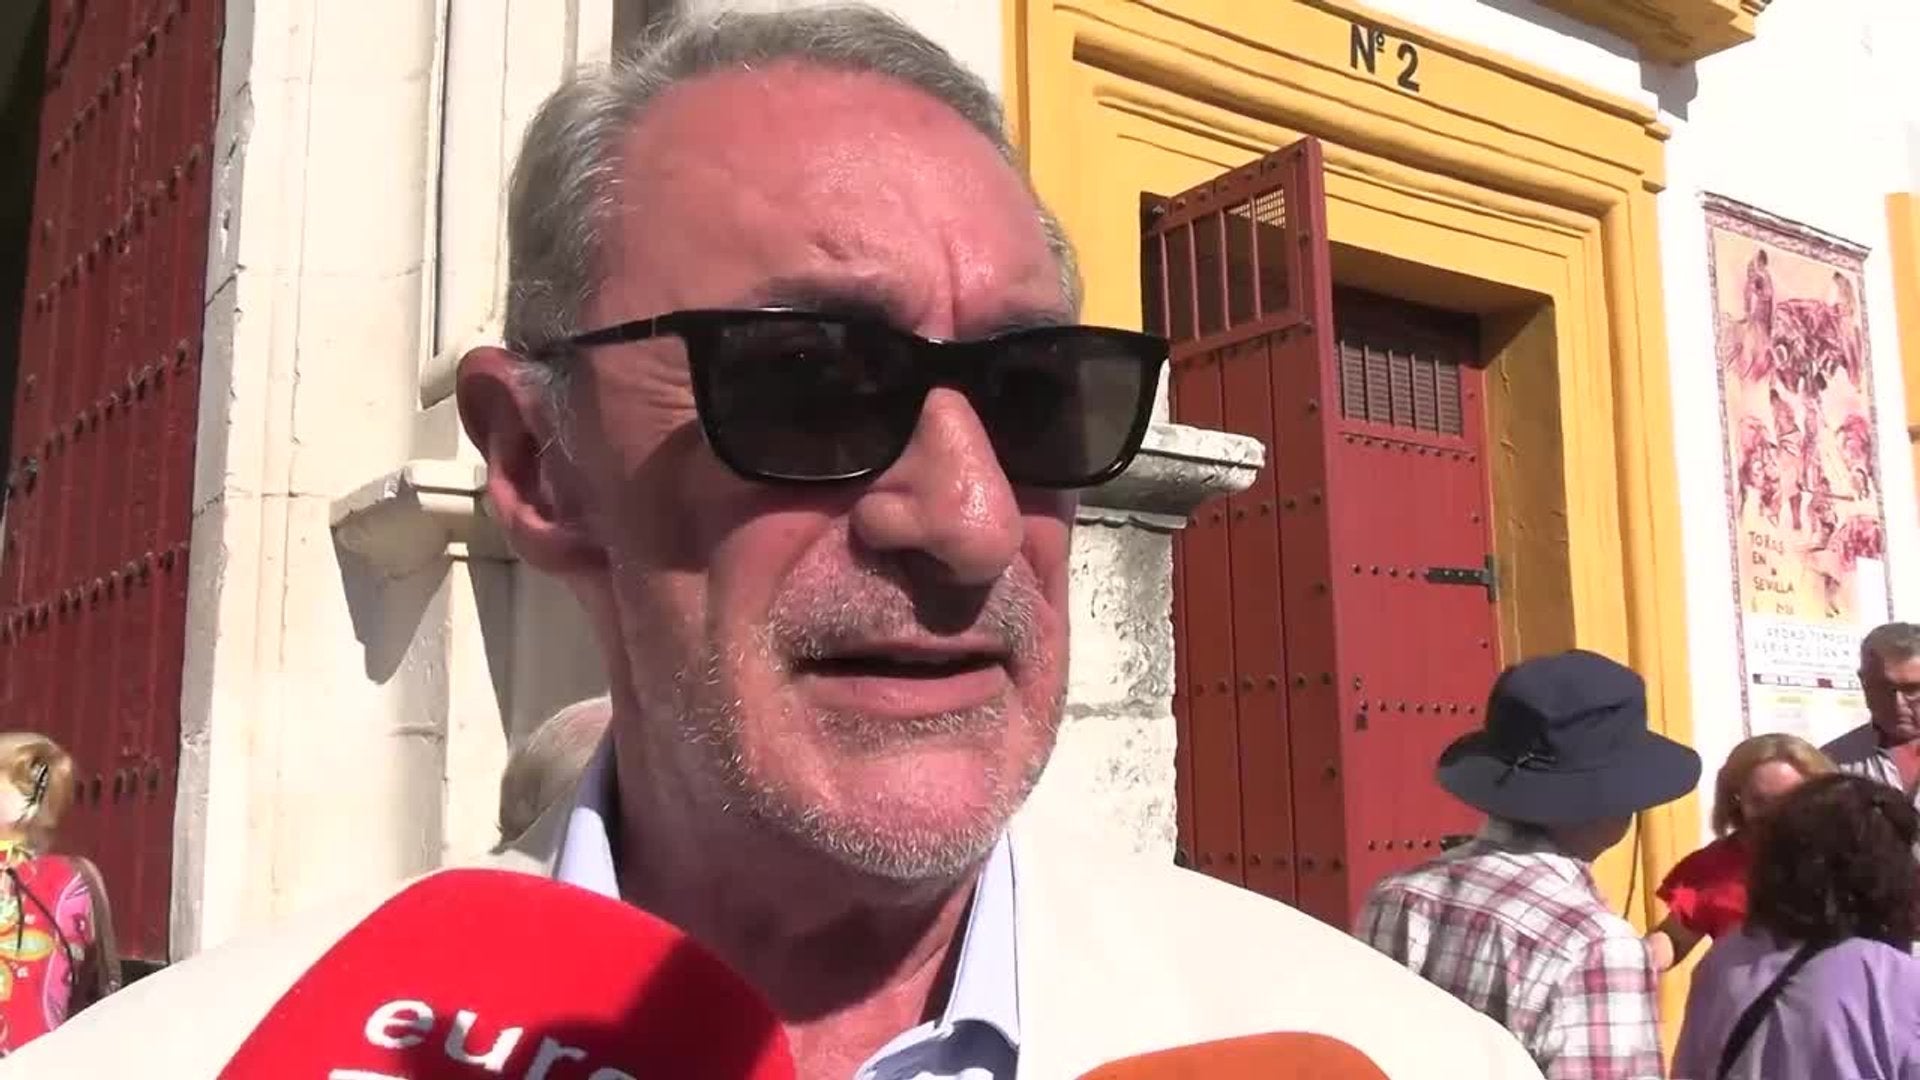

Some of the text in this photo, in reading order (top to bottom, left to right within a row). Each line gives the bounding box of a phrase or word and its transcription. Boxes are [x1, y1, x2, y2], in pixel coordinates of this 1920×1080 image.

[1397, 42, 1420, 93] 2
[1752, 551, 1766, 565] EN
[1753, 576, 1794, 594] SEVILLA
